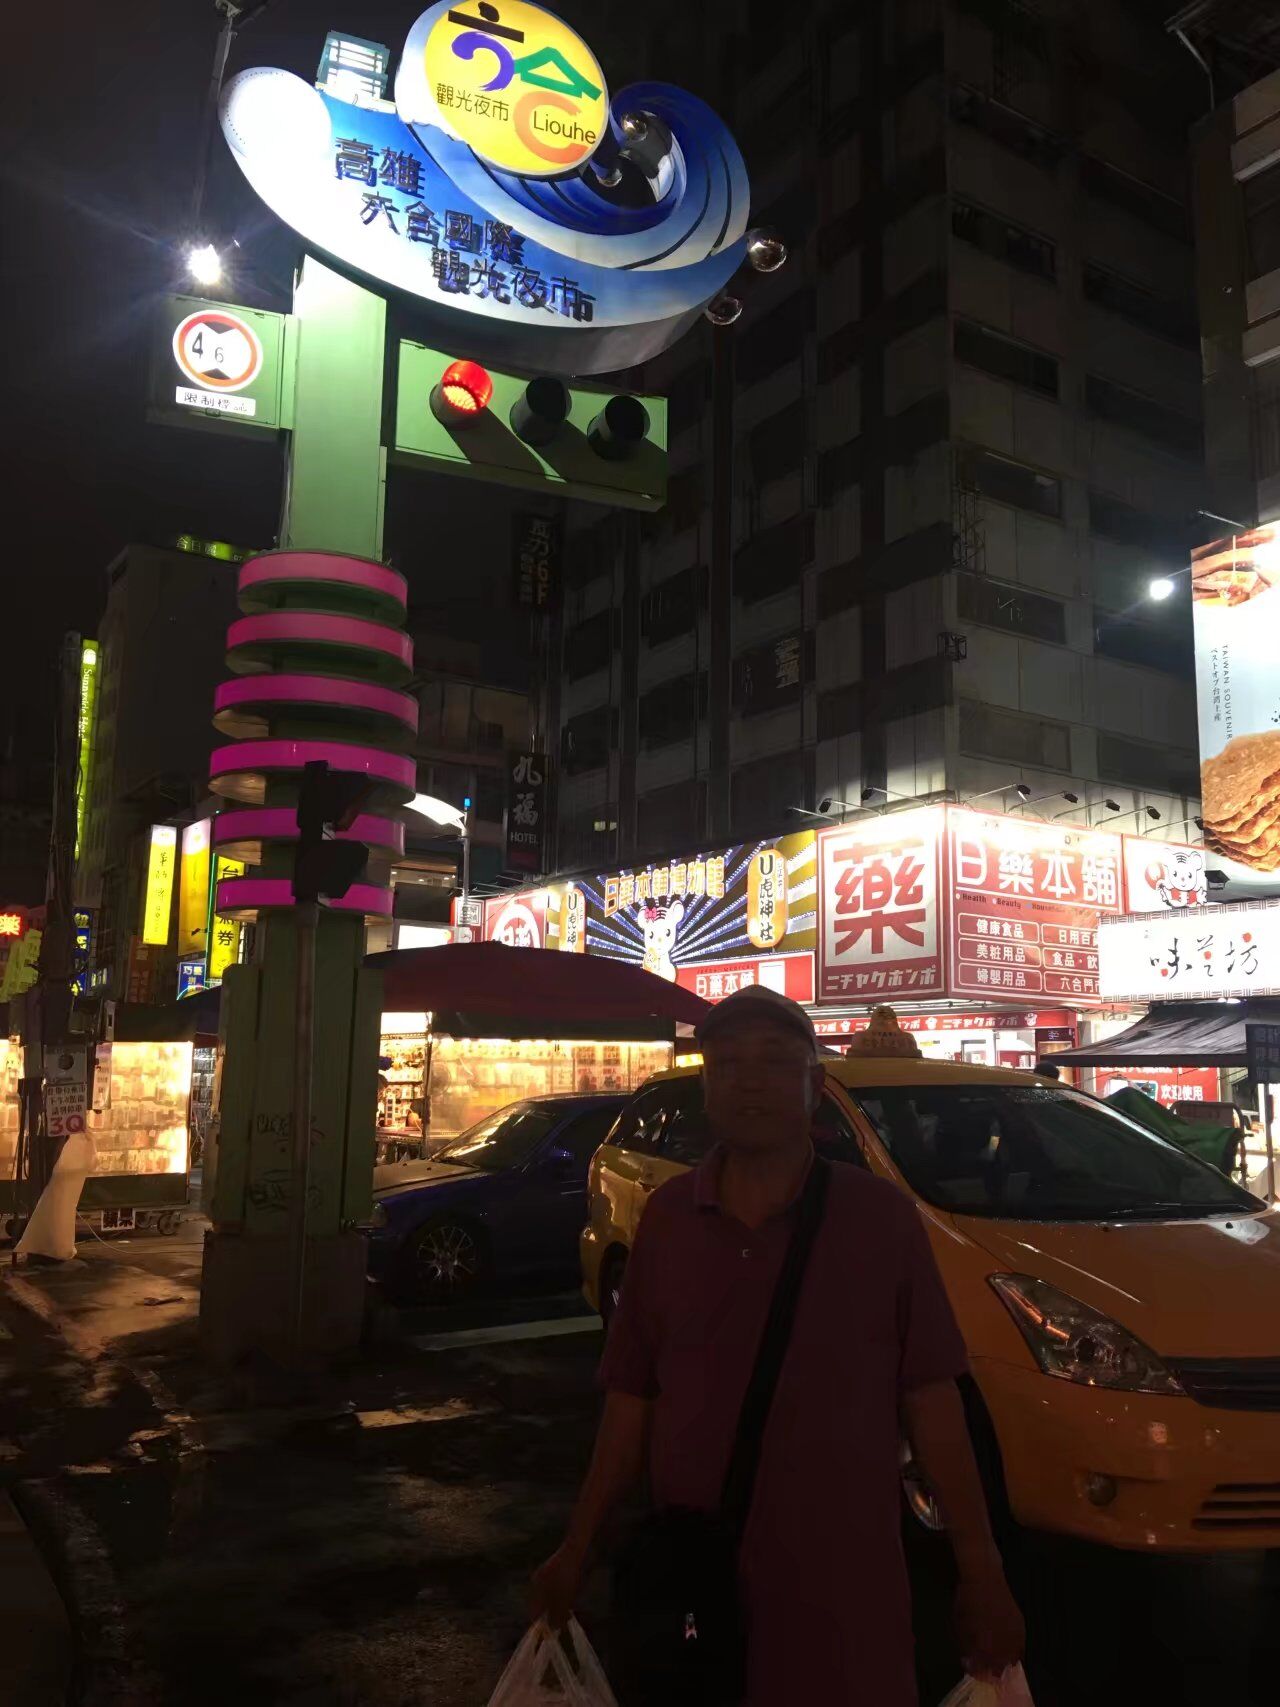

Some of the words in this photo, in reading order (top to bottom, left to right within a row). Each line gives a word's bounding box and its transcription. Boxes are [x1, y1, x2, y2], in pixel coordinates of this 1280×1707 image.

[436, 82, 510, 122] 觀光夜市
[533, 110, 597, 145] Liouhe
[335, 138, 424, 198] 高雄
[359, 190, 520, 260] 六合國際
[430, 246, 591, 320] 觀光夜市
[1221, 643, 1231, 684] TAIWAN
[1223, 688, 1233, 740] SOUVENIR
[510, 831, 541, 845] HOTEL
[962, 893, 987, 904] Health
[996, 897, 1022, 910] Beauty
[976, 918, 1025, 939] 健康食品
[976, 943, 1026, 963] 美粧用品
[976, 967, 1026, 987] 婦嬰用品
